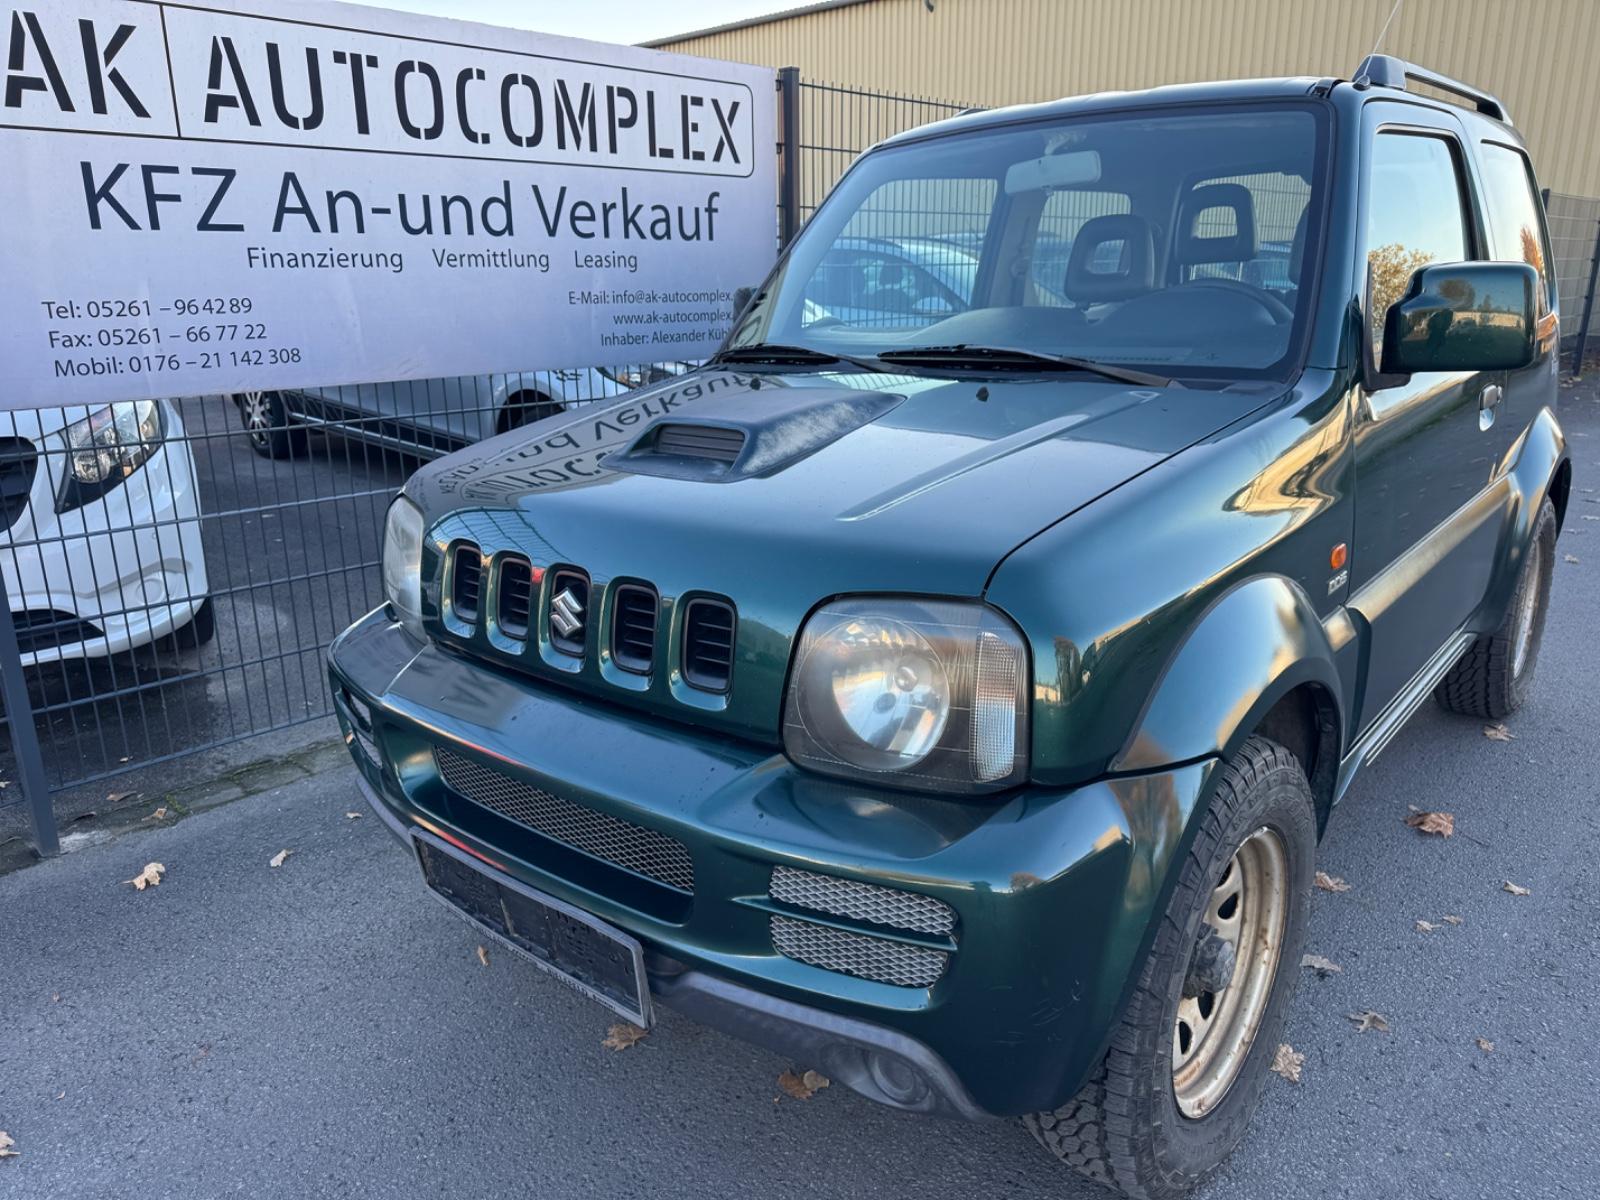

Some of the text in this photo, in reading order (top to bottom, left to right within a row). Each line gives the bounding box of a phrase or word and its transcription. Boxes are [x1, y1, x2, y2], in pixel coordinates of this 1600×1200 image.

[5, 10, 741, 165] AK AUTOCOMPLEX
[80, 161, 720, 241] KFZ An-und Verkauf
[247, 247, 638, 273] Finanzierung Vermittlung Leasing
[568, 289, 734, 305] E-Mail: info@ak-autocomplex.
[41, 300, 82, 319] Tel:
[87, 300, 151, 318] 05261
[613, 309, 734, 325] www.ak-autocomplex.
[48, 331, 93, 348] Fax:
[98, 328, 161, 346] 05261
[186, 326, 211, 342] 66
[216, 325, 238, 341] 77
[244, 324, 267, 340] 22
[601, 327, 730, 346] Inhaber: Alexander Küh
[54, 356, 124, 377] Mobil:
[129, 354, 180, 373] 0176
[200, 353, 221, 369] 21
[231, 350, 264, 367] 142
[269, 348, 301, 365] 308
